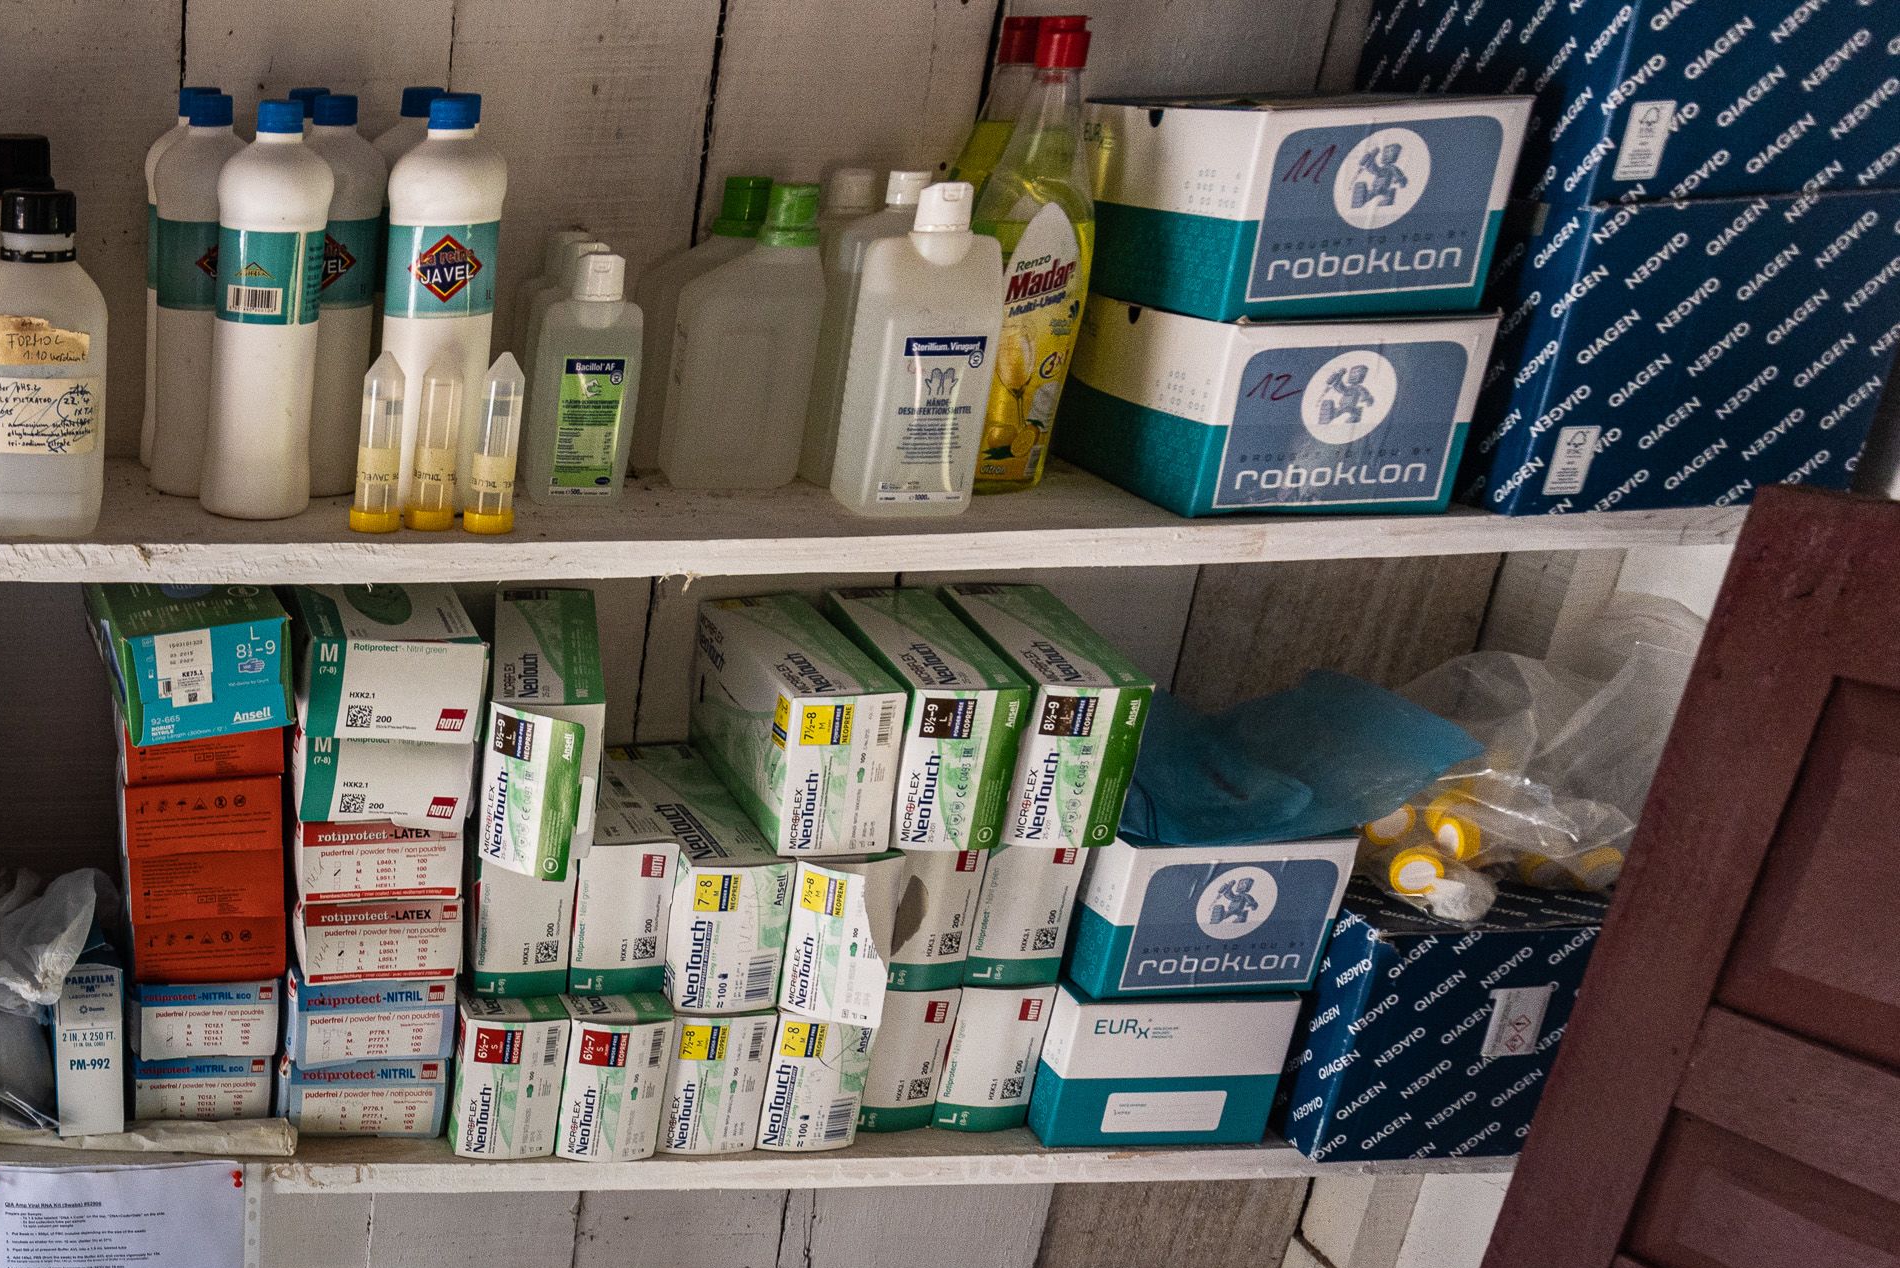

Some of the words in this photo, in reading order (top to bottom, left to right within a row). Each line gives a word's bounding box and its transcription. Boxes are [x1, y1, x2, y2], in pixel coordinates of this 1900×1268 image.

[1585, 5, 1633, 65] QIAGEN
[1684, 16, 1755, 80] QIAGEN
[1801, 28, 1872, 93] QIAGEN
[1716, 64, 1786, 128] QIAGEN
[1745, 112, 1817, 174] QIAGEN
[1564, 137, 1615, 192] QIAGEN
[1533, 216, 1580, 269] QIAGEN
[1705, 198, 1770, 256] QIAGEN
[1814, 210, 1879, 269] QIAGEN
[421, 265, 474, 285] JAVEL
[1016, 254, 1051, 273] Renzo
[1267, 247, 1462, 281] roboklon
[1005, 258, 1076, 305] Madar
[1550, 264, 1610, 319] QIAGEN
[1656, 276, 1722, 335] QIAGEN
[605, 363, 616, 371] AF
[1637, 396, 1702, 451] QIAGEN
[1235, 462, 1428, 492] roboklon
[250, 626, 260, 640] L
[319, 665, 337, 674] (7-8)
[320, 643, 339, 662] M
[353, 643, 399, 653] Rotiprotect
[426, 646, 448, 655] green
[233, 707, 272, 722] Ansell
[437, 718, 462, 731] ROTH
[804, 712, 817, 740] 7½-8
[842, 706, 852, 744] NEOPRENE
[923, 703, 939, 733] 8½-9
[1005, 701, 1019, 728] Ansell
[1043, 701, 1060, 731] 8½-9
[524, 724, 534, 761] NEOPRENE
[563, 733, 573, 761] Ansell
[798, 772, 819, 850] NeoTouch
[911, 754, 942, 843] NeoTouch
[1026, 752, 1060, 840] NeoTouch
[490, 768, 509, 859] NeoTouch
[321, 849, 354, 858] puderfrei
[360, 848, 385, 857] powder
[651, 856, 665, 877] ROTH
[774, 874, 787, 907] Ansell
[645, 919, 653, 933] 200
[682, 919, 707, 1008] NeoTouch
[795, 936, 814, 1008] NeoTouch
[973, 966, 992, 979] L
[1138, 952, 1301, 976] roboklon
[1387, 934, 1440, 980] QIAGEN
[65, 974, 115, 987] PARAFILM
[236, 992, 252, 1000] ECO
[1413, 969, 1467, 1013] QIAGEN
[1027, 1000, 1042, 1021] ROTH
[62, 1032, 68, 1042] 2
[82, 1032, 87, 1041] X
[89, 1032, 103, 1042] 250
[106, 1031, 116, 1041] FT.
[478, 1033, 491, 1059] 6½-7
[582, 1035, 595, 1061] 6½-7
[69, 1058, 111, 1071] PM-992
[473, 1086, 492, 1153] NeoTouch
[576, 1088, 597, 1155] NeoTouch
[763, 1064, 792, 1146] NeoTouch
[1360, 1111, 1412, 1151] QIAGEN
